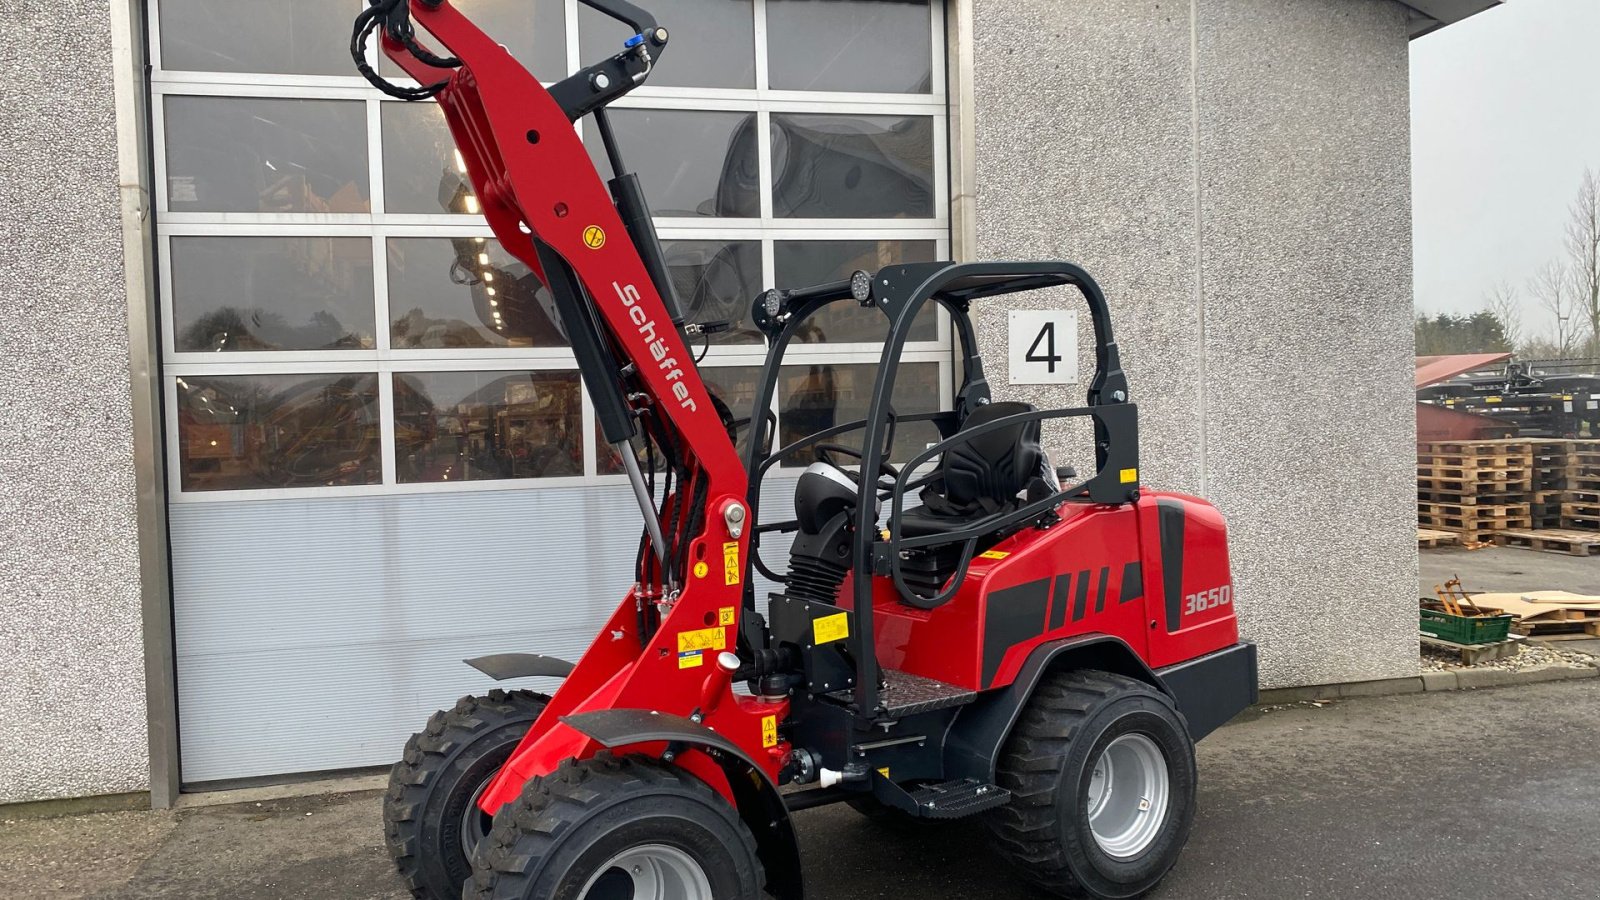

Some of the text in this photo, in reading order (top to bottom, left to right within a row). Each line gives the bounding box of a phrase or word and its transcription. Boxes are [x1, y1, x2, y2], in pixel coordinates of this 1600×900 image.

[612, 281, 697, 412] Schäffer
[1025, 322, 1062, 373] 4
[1184, 585, 1231, 616] 3650
